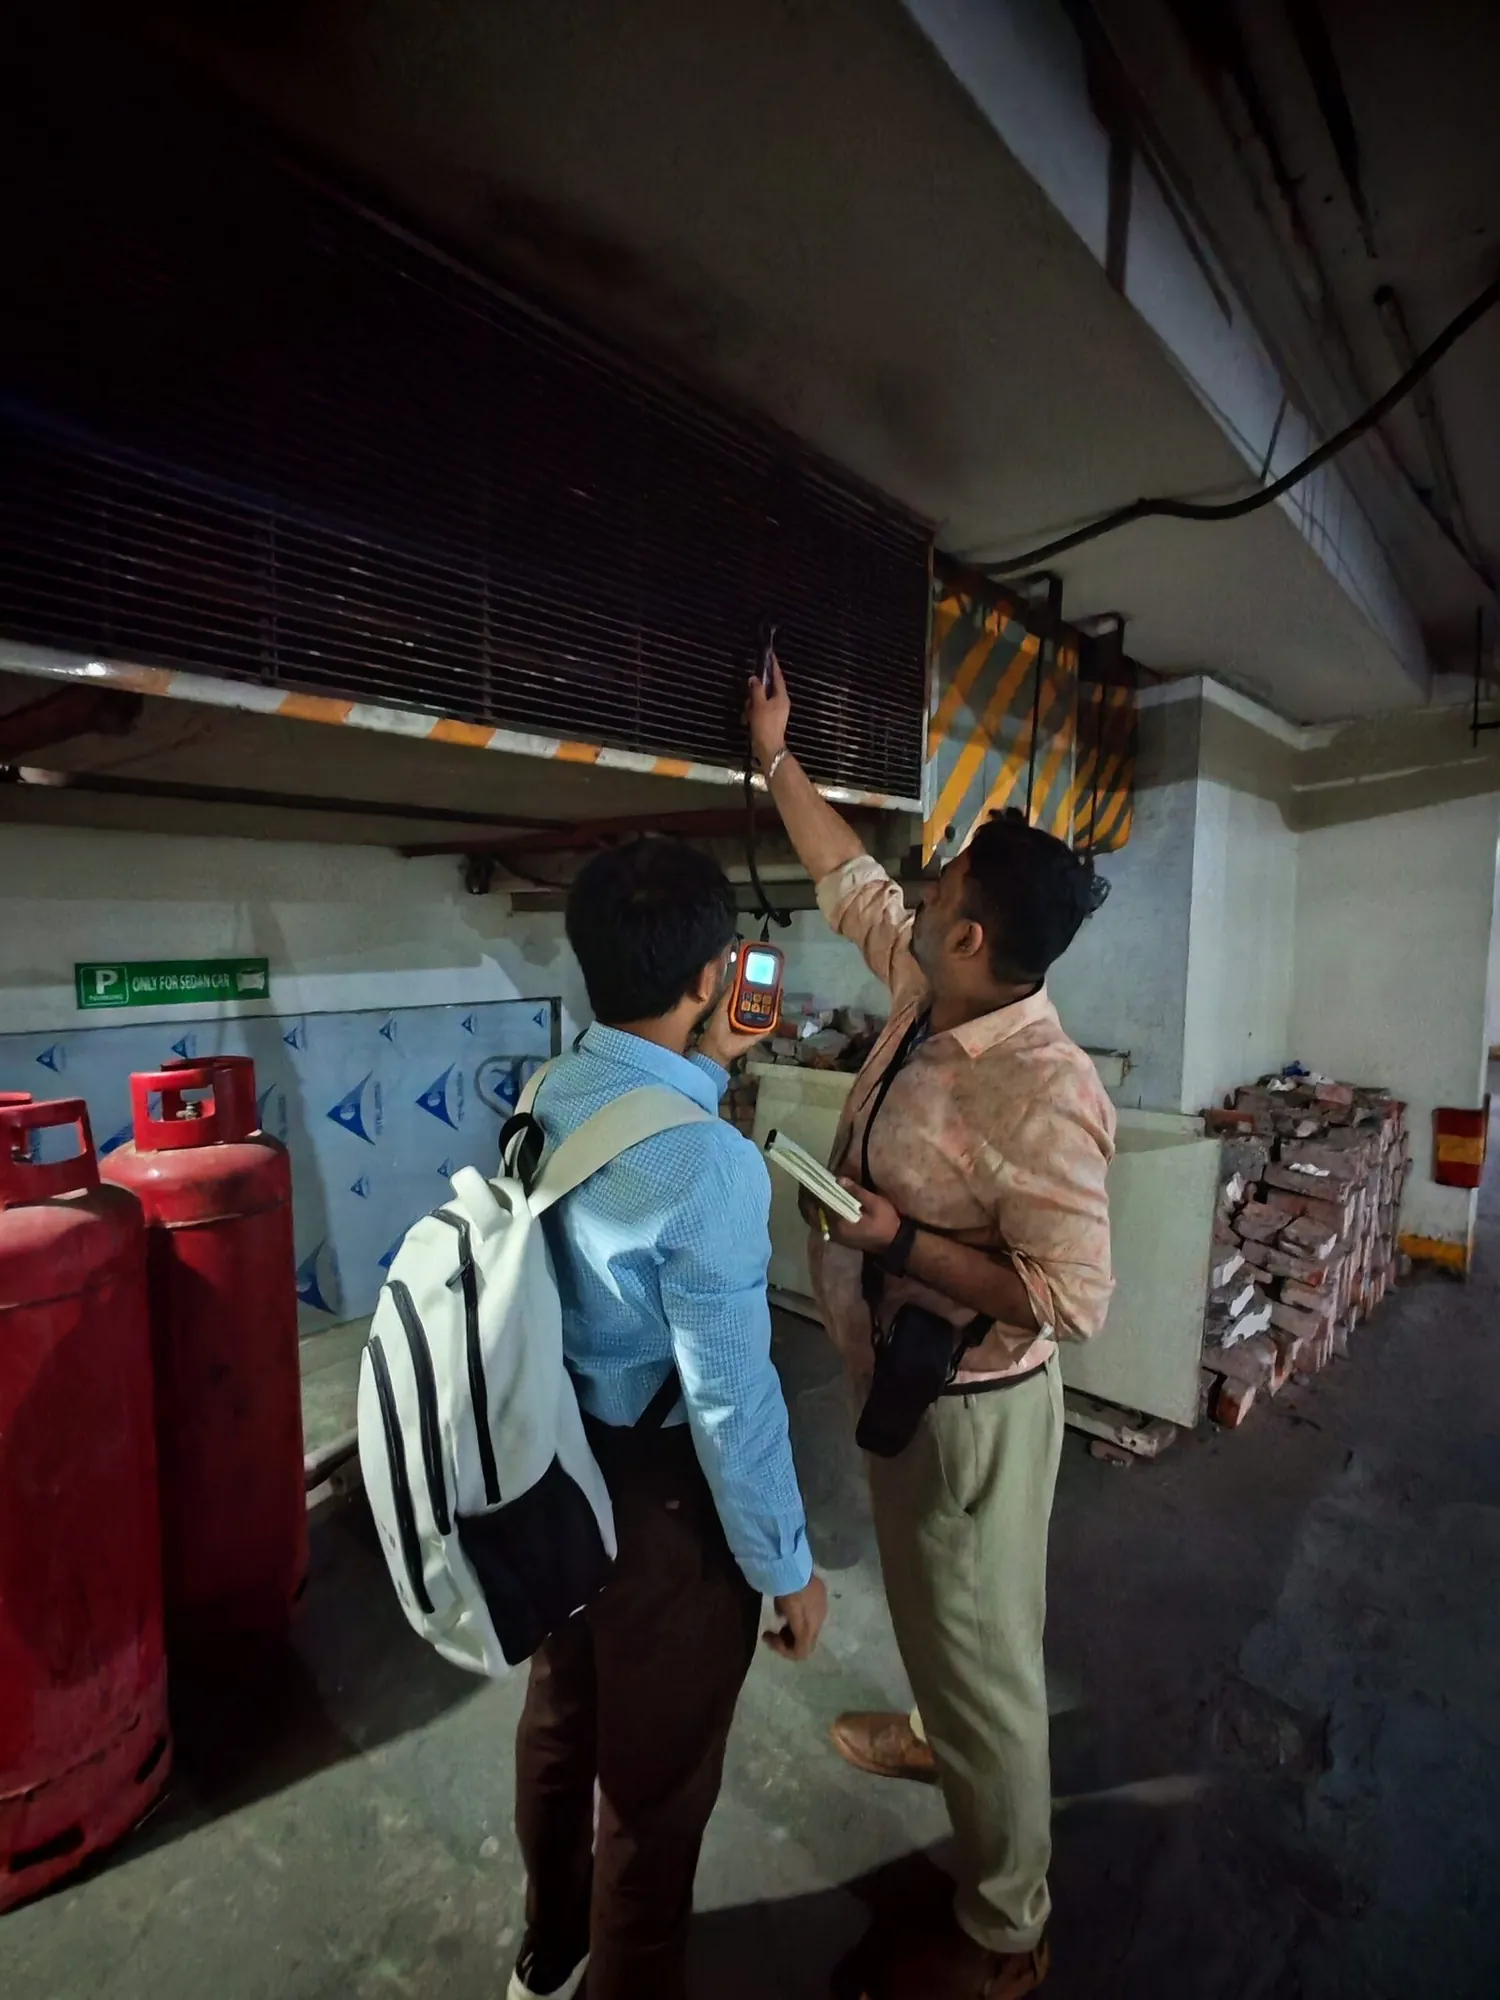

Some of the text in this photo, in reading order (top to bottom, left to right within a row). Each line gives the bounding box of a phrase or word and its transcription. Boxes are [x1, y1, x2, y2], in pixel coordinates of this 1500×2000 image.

[96, 970, 118, 994] P
[132, 974, 230, 992] ONLY FOR SEDAN CAR
